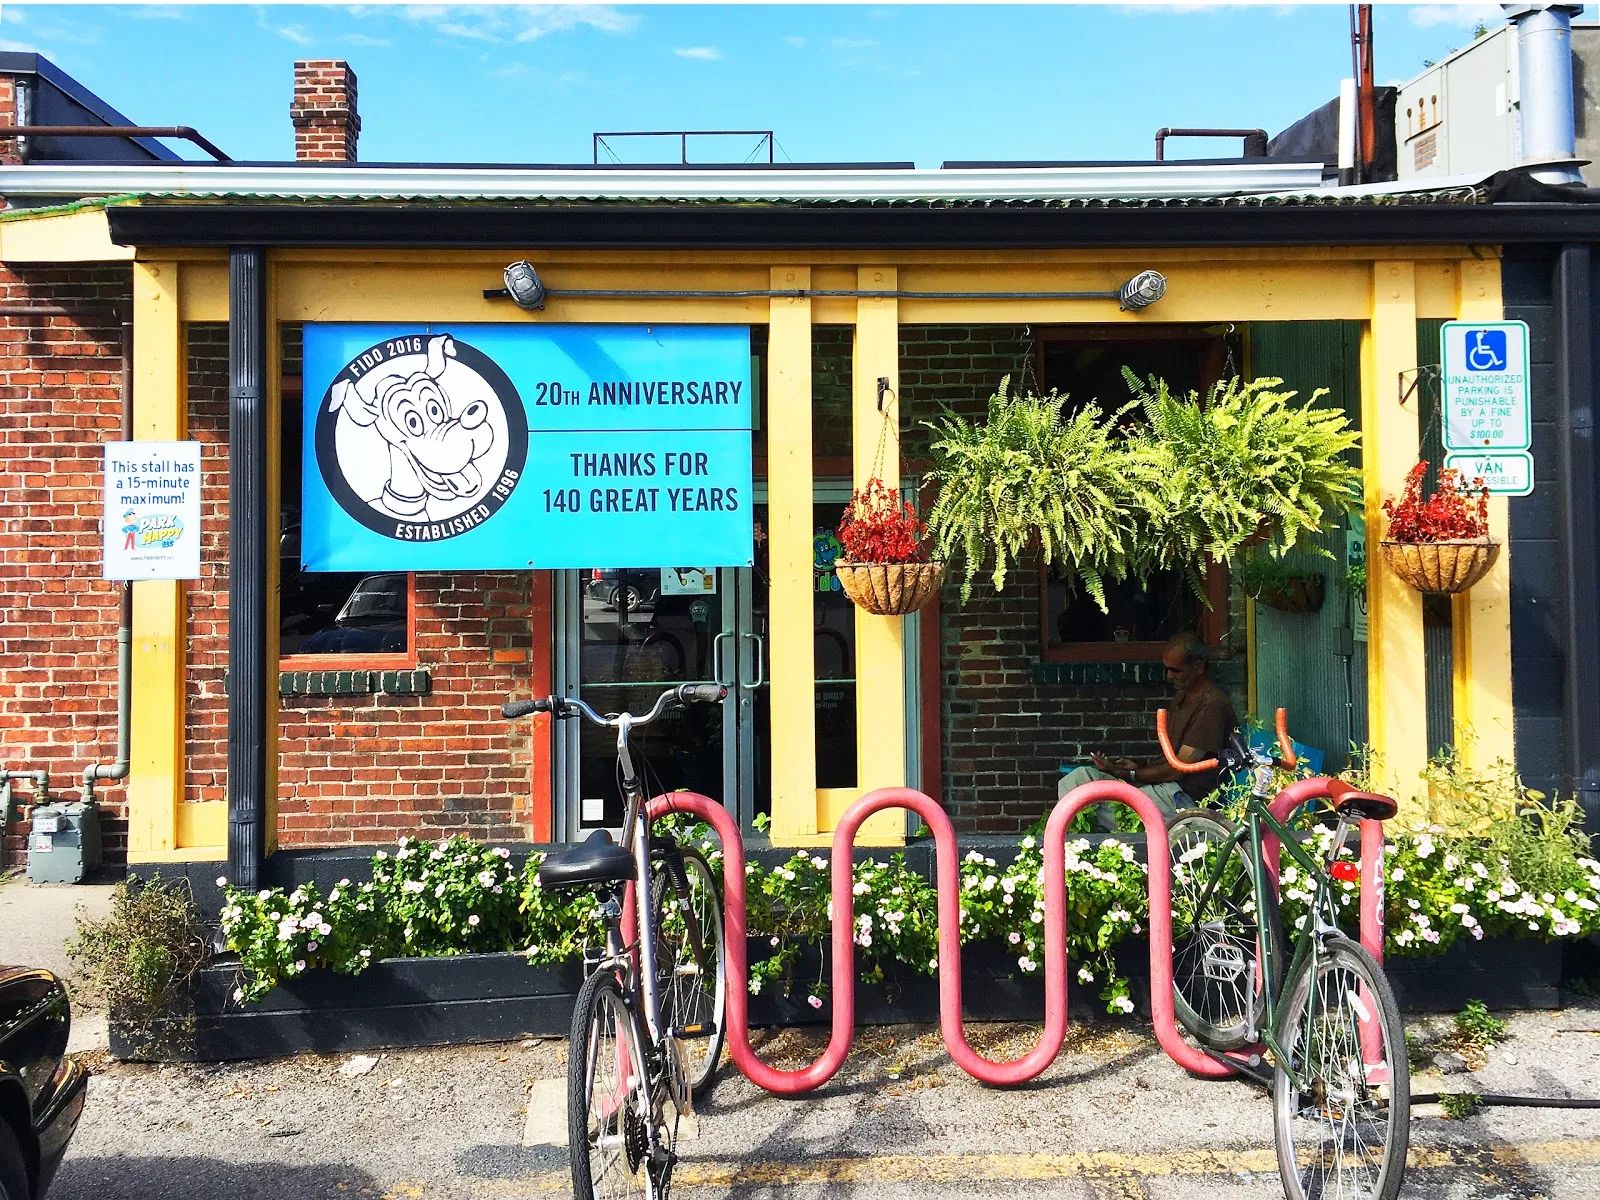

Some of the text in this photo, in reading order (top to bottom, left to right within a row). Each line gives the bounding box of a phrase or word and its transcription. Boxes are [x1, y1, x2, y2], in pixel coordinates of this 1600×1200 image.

[349, 338, 422, 377] FIDO 2016
[1448, 375, 1523, 384] UNAUTHORIZED
[588, 381, 743, 405] ANNIVERSARY
[1458, 386, 1513, 395] PARKING IS
[1455, 397, 1517, 406] PUNISHABLE
[1461, 408, 1512, 417] BY A FINE
[1472, 419, 1502, 427] UP TO
[1470, 430, 1504, 439] $100.00
[112, 460, 195, 473] This stall has
[570, 453, 709, 477] THANKS FOR
[1475, 462, 1503, 474] VAN
[116, 477, 190, 489] a 15-minute
[120, 492, 185, 505] maximum!
[395, 469, 519, 540] ESTABLISHED 1996
[543, 487, 739, 513] 140 GREAT YEARS
[138, 514, 177, 534] PARK
[141, 527, 183, 546] HAPPY
[814, 572, 841, 592] ido
